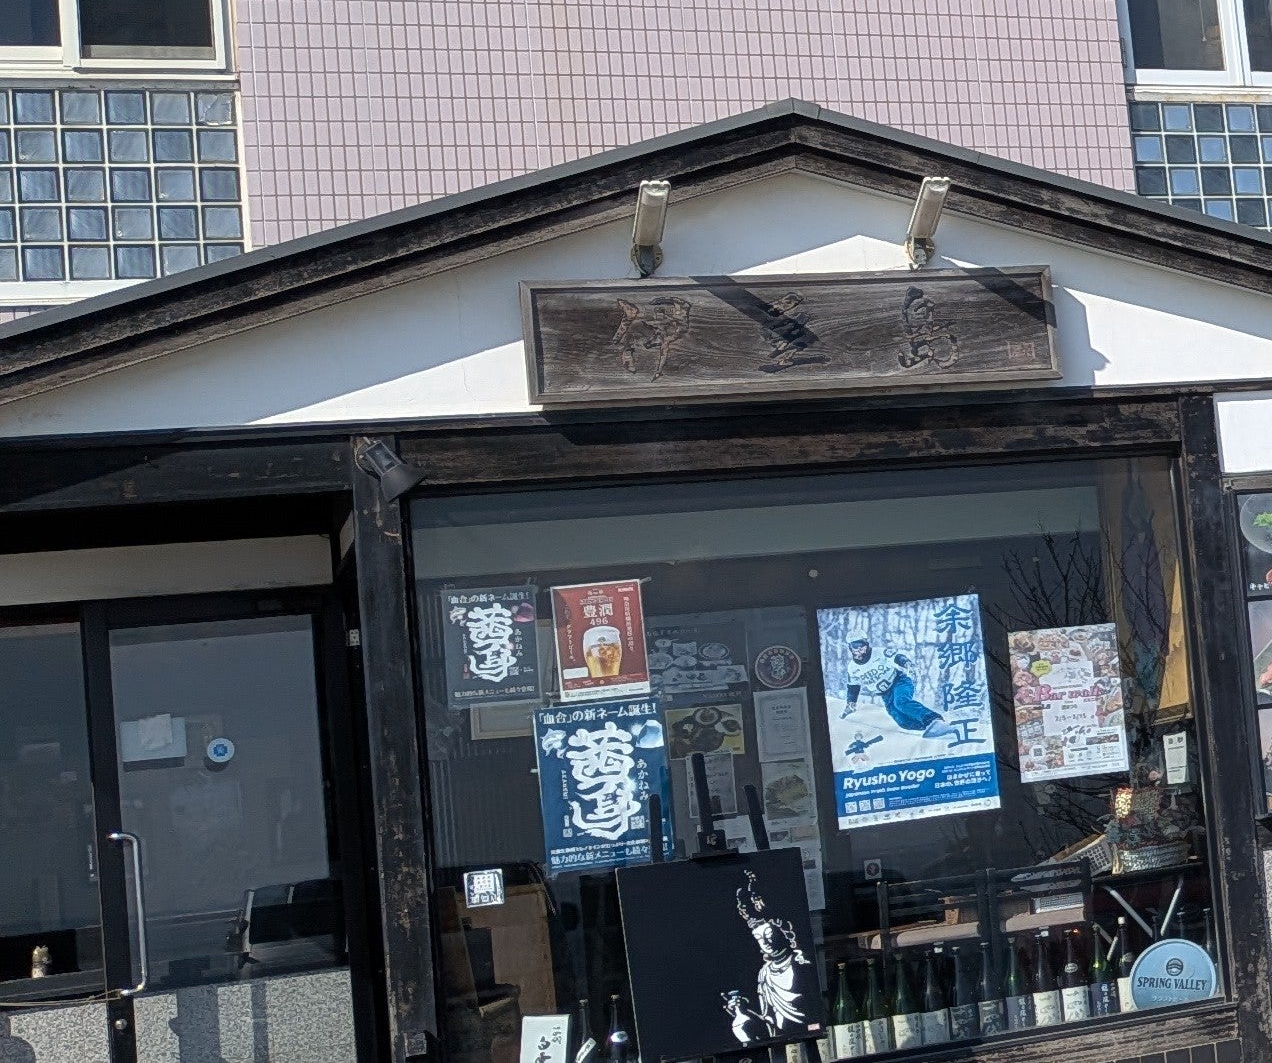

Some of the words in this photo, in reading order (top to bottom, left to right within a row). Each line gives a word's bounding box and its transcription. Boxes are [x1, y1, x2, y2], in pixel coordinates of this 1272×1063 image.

[590, 617, 608, 626] 496
[932, 603, 987, 749] 余郷隆正
[636, 758, 650, 801] あかねみ
[842, 772, 897, 791] Ryusho
[898, 767, 936, 785] Yogo
[1136, 976, 1172, 989] SPRING
[1173, 978, 1208, 991] VALLEY
